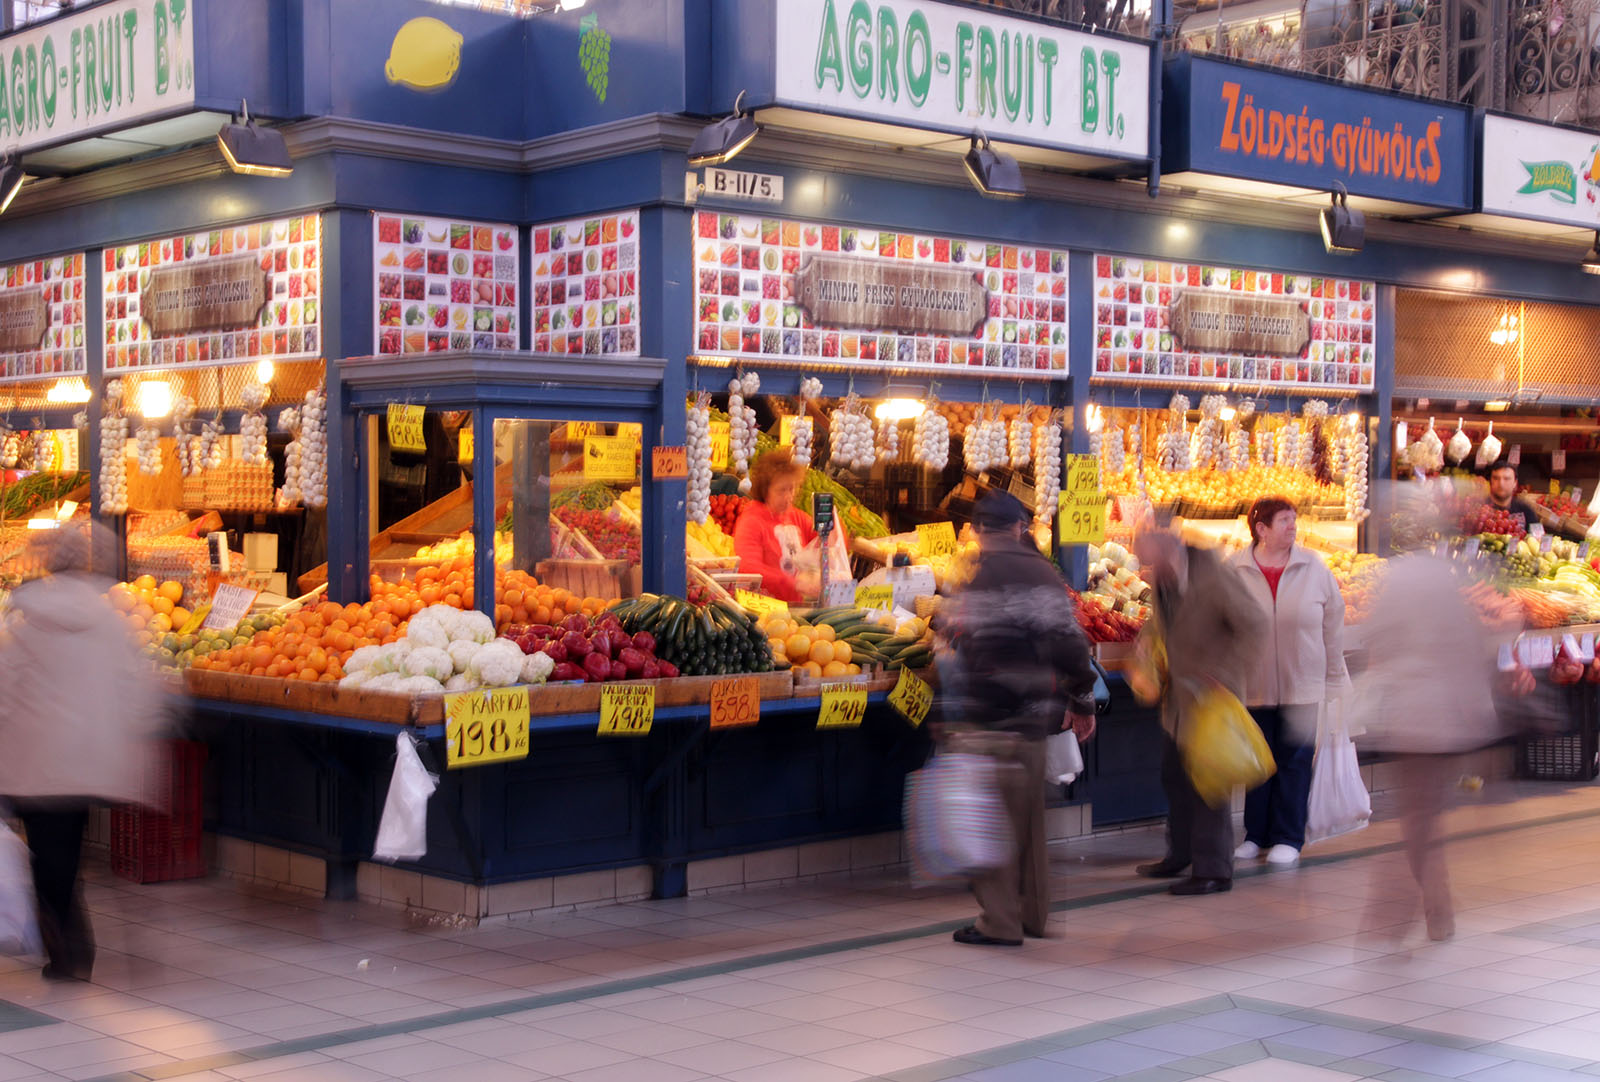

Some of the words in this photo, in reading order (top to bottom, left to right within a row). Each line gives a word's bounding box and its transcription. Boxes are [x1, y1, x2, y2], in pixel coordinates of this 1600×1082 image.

[0, 8, 138, 137] AGRO-FRUIT
[153, 0, 192, 96] BT.
[815, 0, 1058, 127] AGRO-FRUIT
[1079, 45, 1125, 140] BT.
[819, 280, 859, 303] MINDIG
[865, 285, 895, 306] FRISS
[1072, 511, 1092, 535] 99
[714, 693, 750, 723] 398
[454, 718, 511, 758] 198
